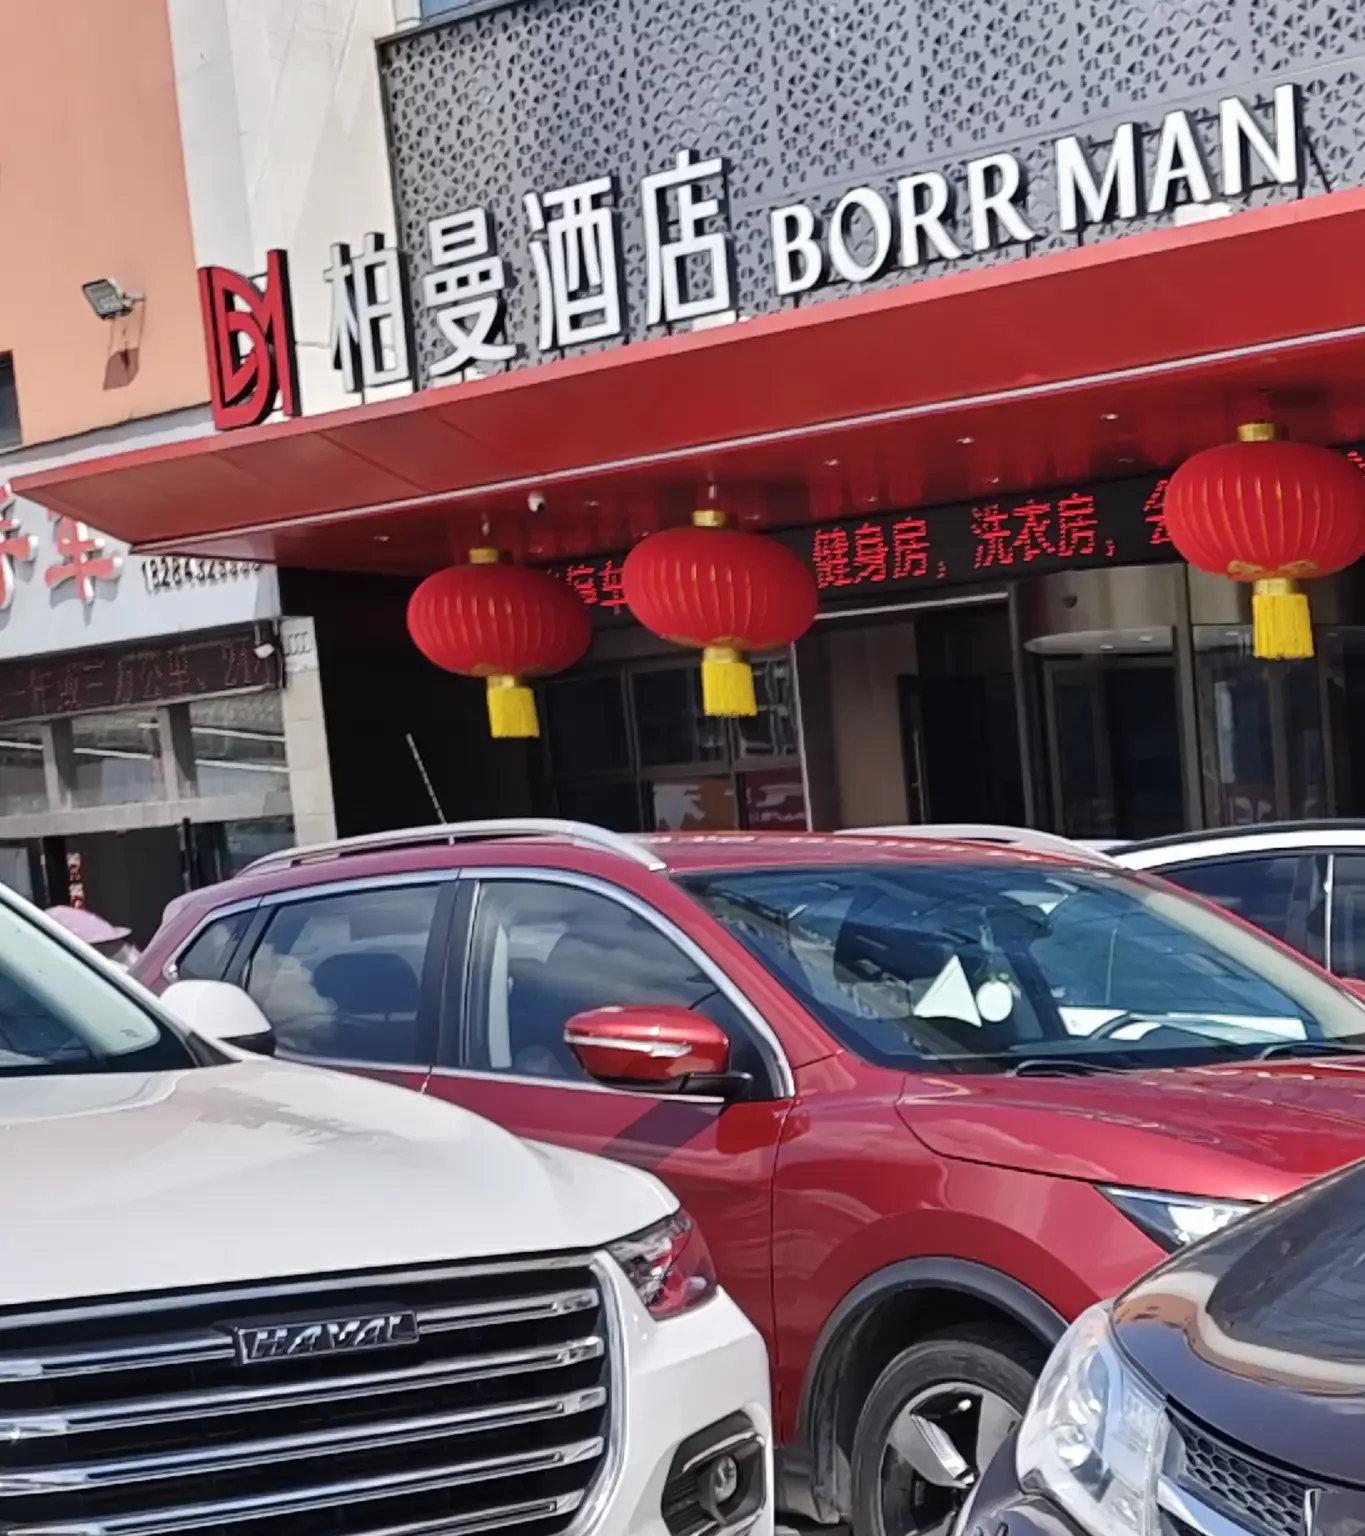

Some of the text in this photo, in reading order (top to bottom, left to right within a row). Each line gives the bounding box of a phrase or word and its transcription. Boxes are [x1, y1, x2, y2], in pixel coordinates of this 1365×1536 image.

[324, 83, 1302, 394] 柏曼酒店 BORR MAN
[253, 1315, 403, 1358] HAVAL
